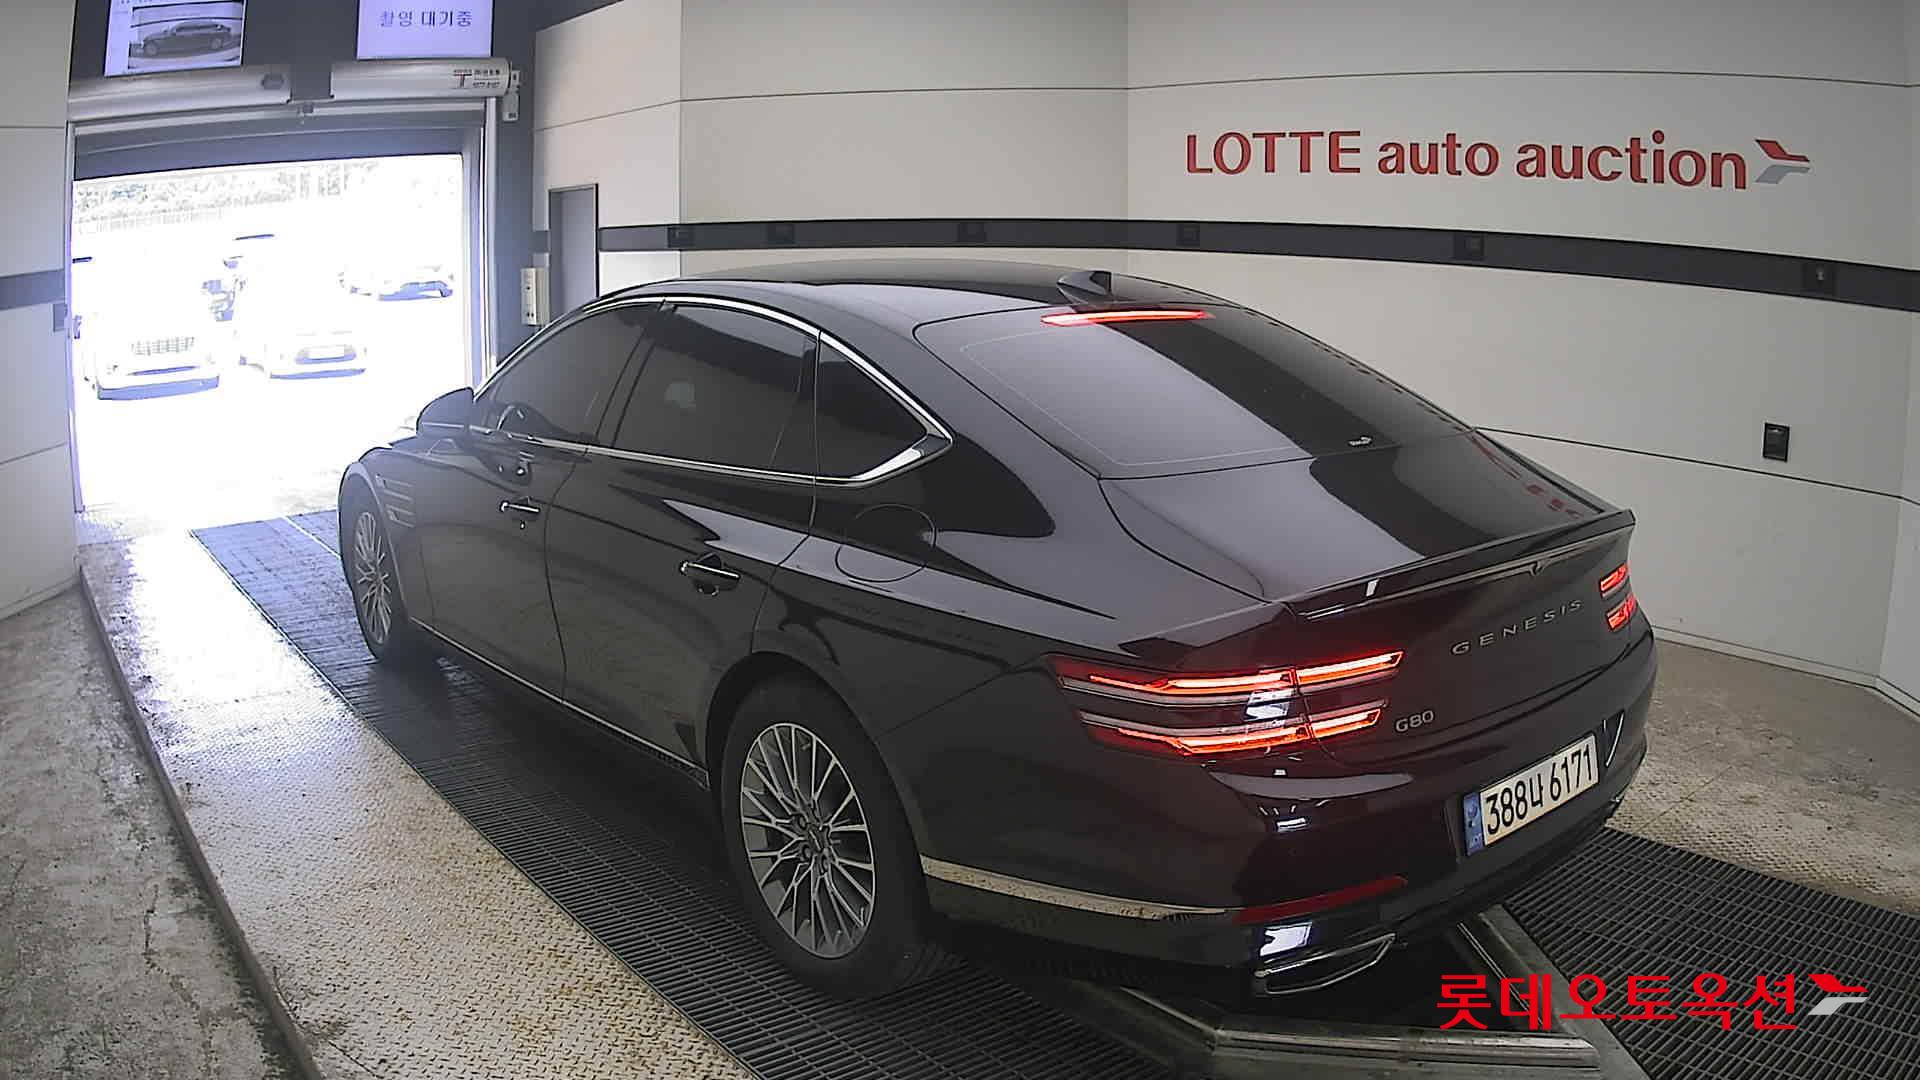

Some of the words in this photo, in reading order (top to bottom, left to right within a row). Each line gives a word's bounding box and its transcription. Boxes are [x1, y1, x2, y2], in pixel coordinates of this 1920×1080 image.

[421, 10, 472, 28] 대기중
[1186, 130, 1361, 175] LOTTE
[1377, 132, 1500, 177] auto
[1515, 129, 1748, 190] auction
[1451, 600, 1583, 656] GENESIS
[1394, 709, 1436, 733] G80
[1485, 772, 1544, 836] 388나
[1549, 743, 1593, 802] 6171
